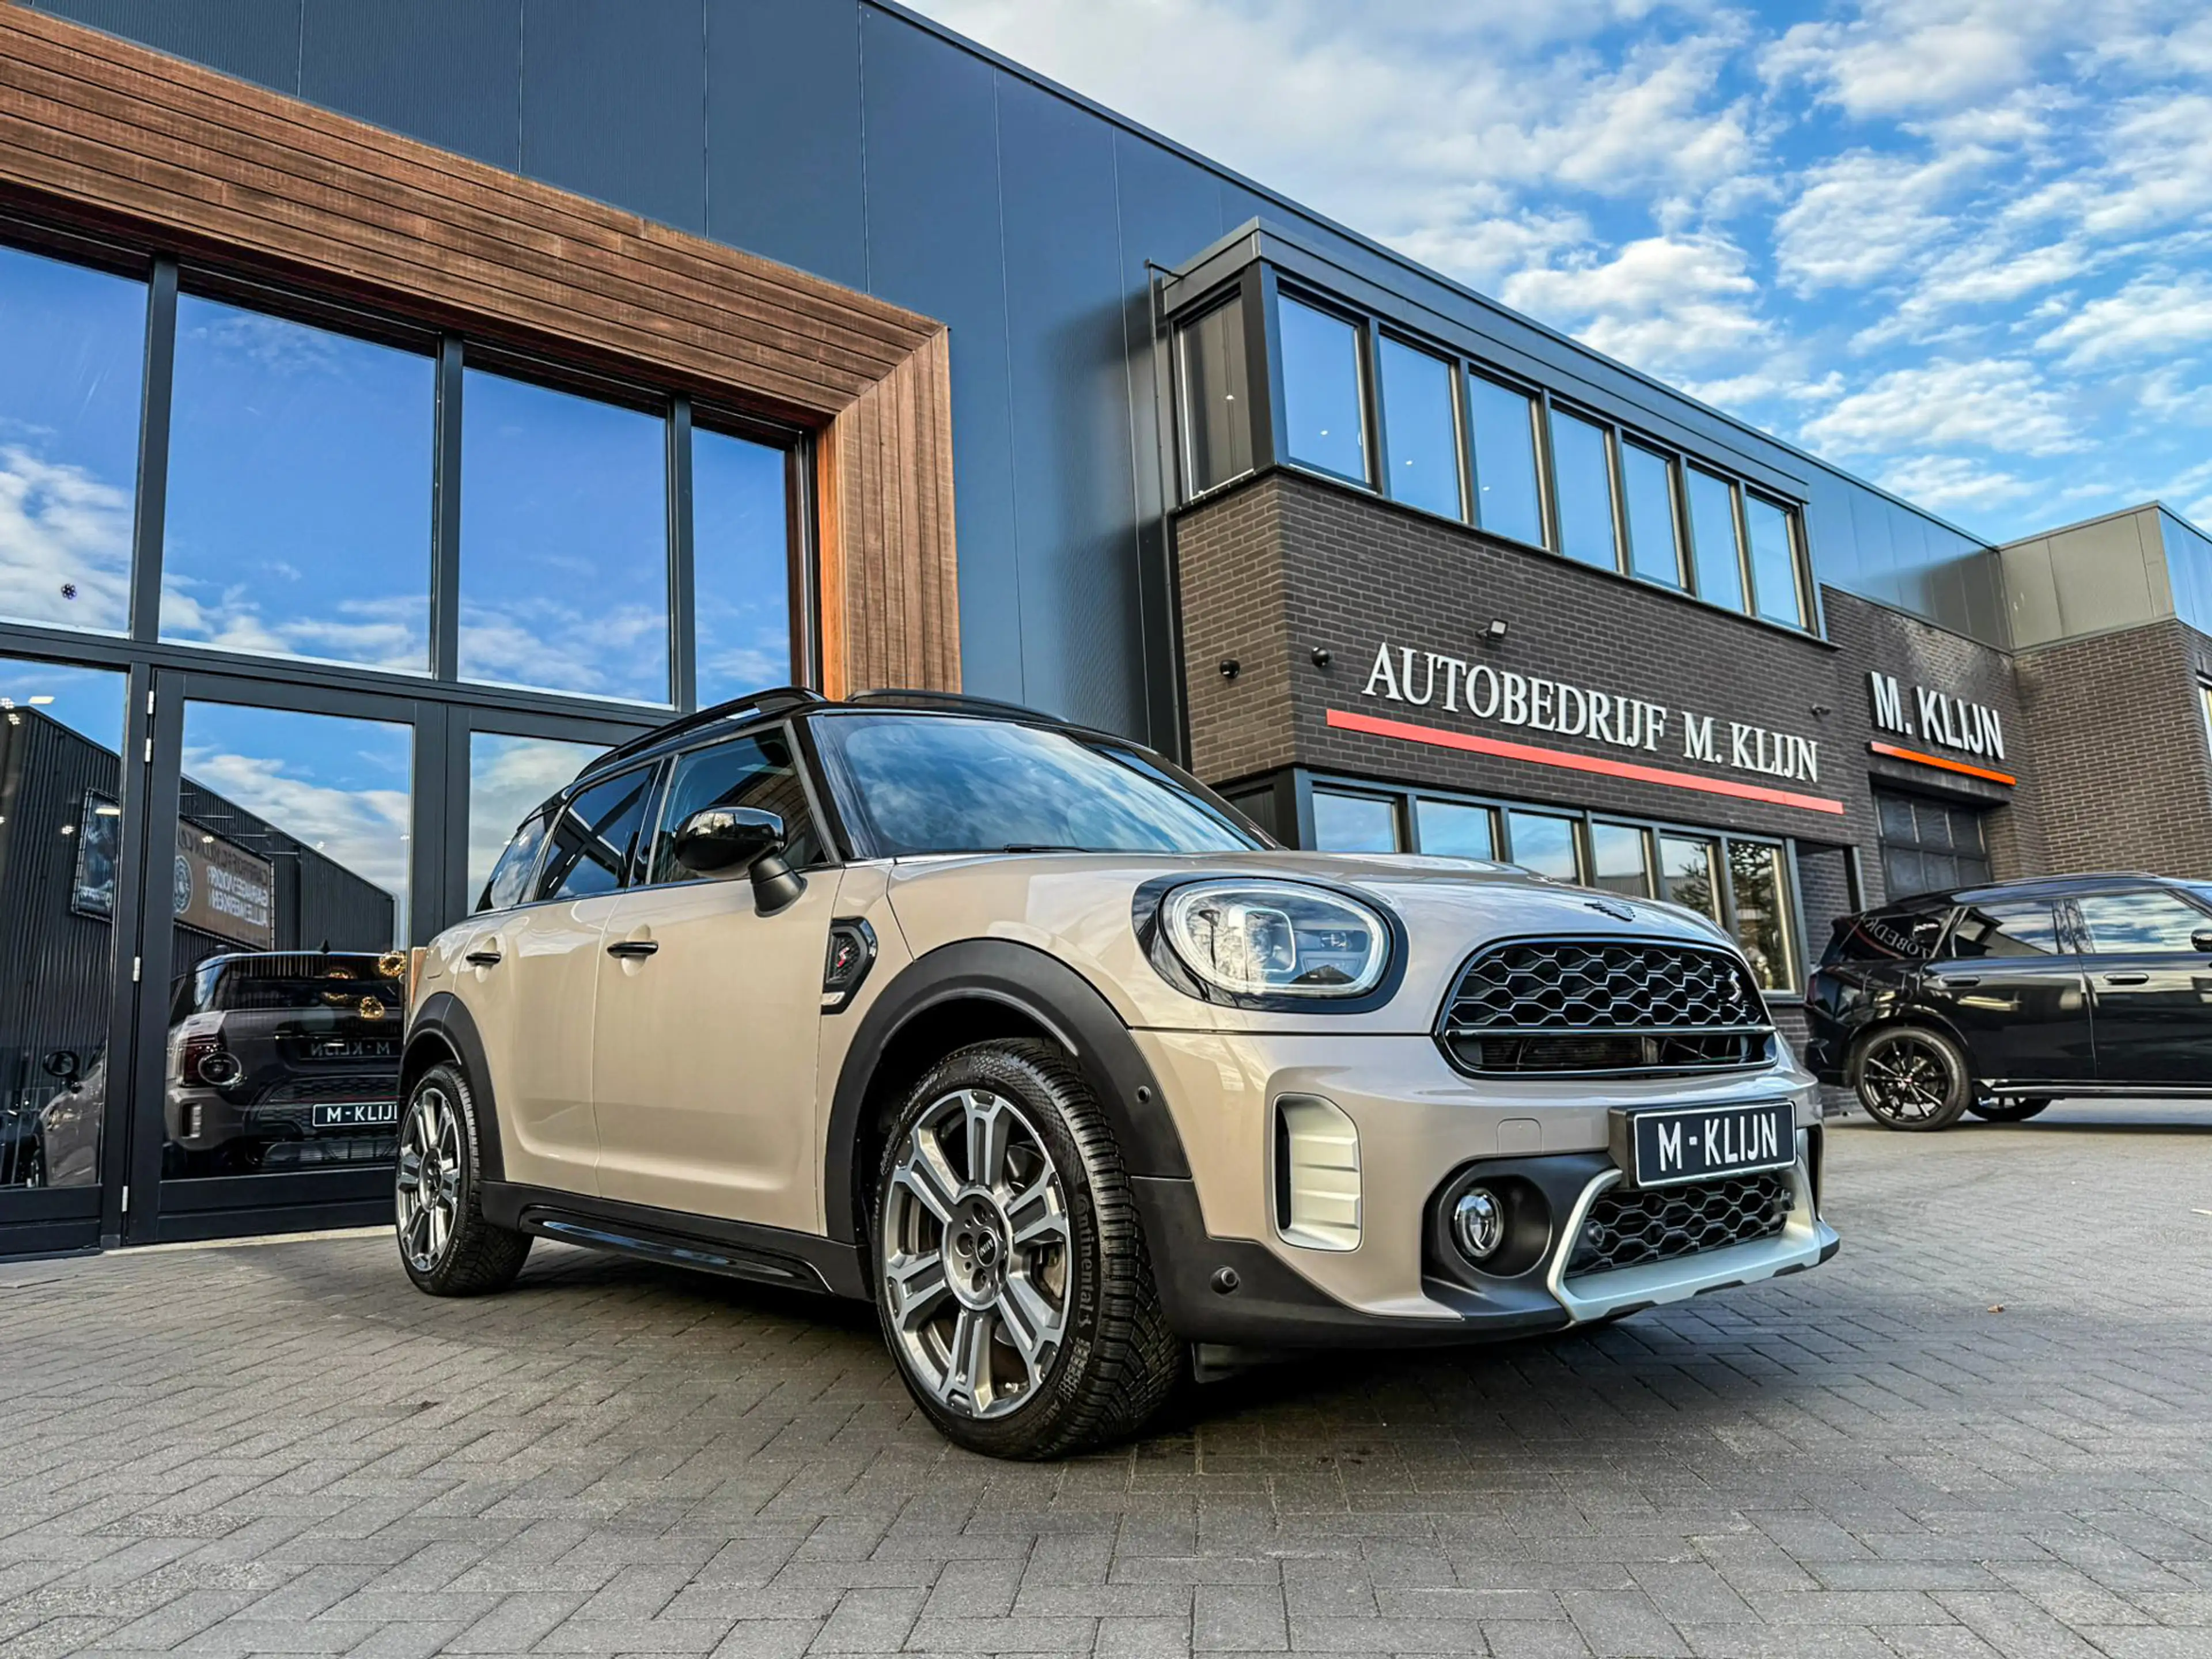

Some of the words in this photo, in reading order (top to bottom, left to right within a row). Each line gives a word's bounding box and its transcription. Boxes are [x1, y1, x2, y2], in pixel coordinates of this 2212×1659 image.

[1361, 641, 1666, 753] AUTOBEDRIJF
[1682, 711, 1722, 764] M.
[1729, 721, 1818, 783] KLIJN
[1869, 671, 1913, 734] M.
[1914, 685, 2005, 760] KLIJN
[1657, 1113, 1778, 1172] M-KLIJN
[1073, 1194, 1095, 1313] Continental
